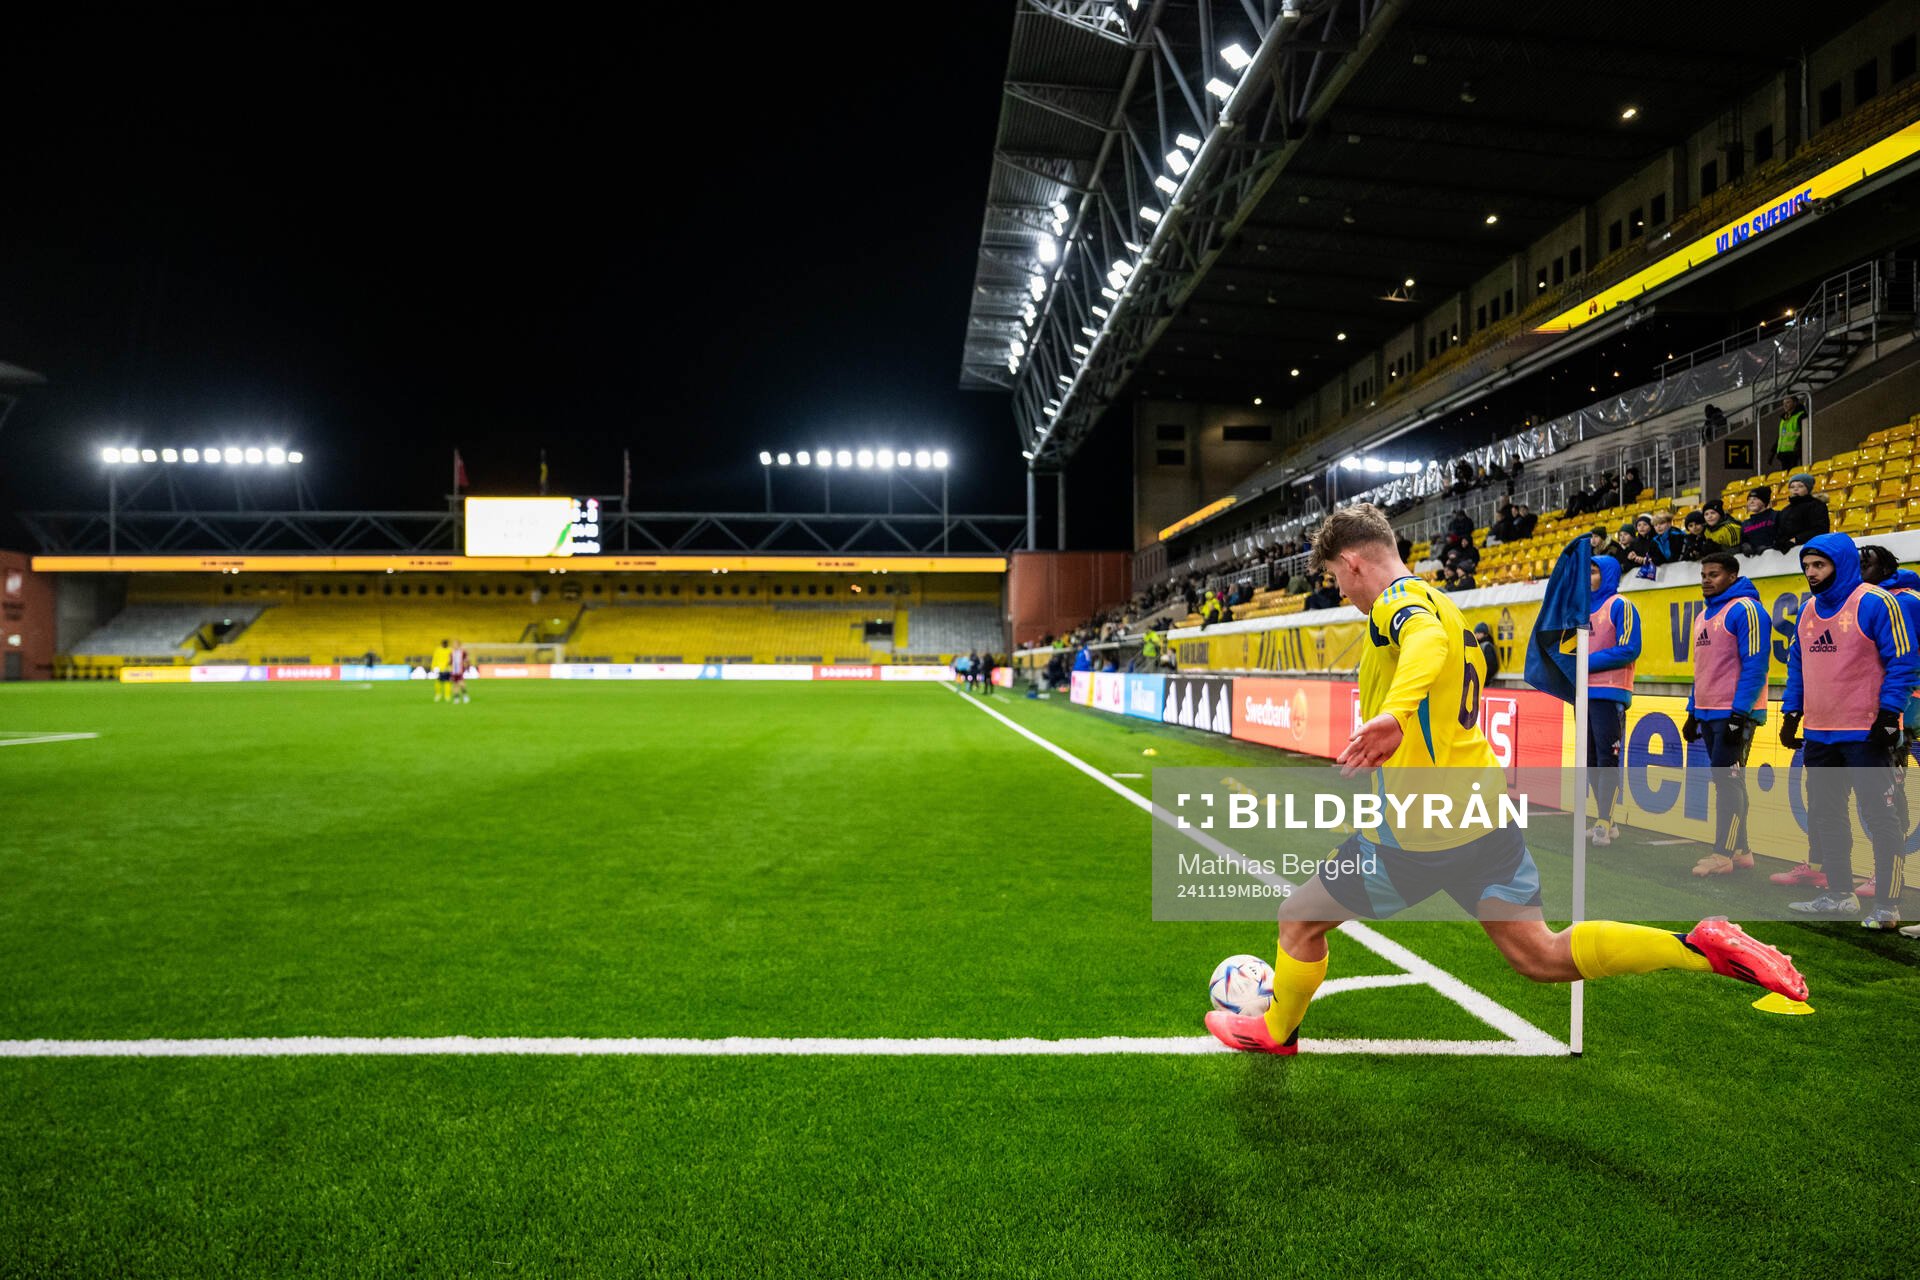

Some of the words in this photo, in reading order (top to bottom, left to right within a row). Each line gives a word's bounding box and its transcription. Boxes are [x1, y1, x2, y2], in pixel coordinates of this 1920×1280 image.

[1728, 445, 1750, 465] F1
[1393, 612, 1406, 630] C
[1808, 643, 1838, 653] adidas
[1458, 628, 1481, 731] 6
[1244, 695, 1291, 729] Swedbank
